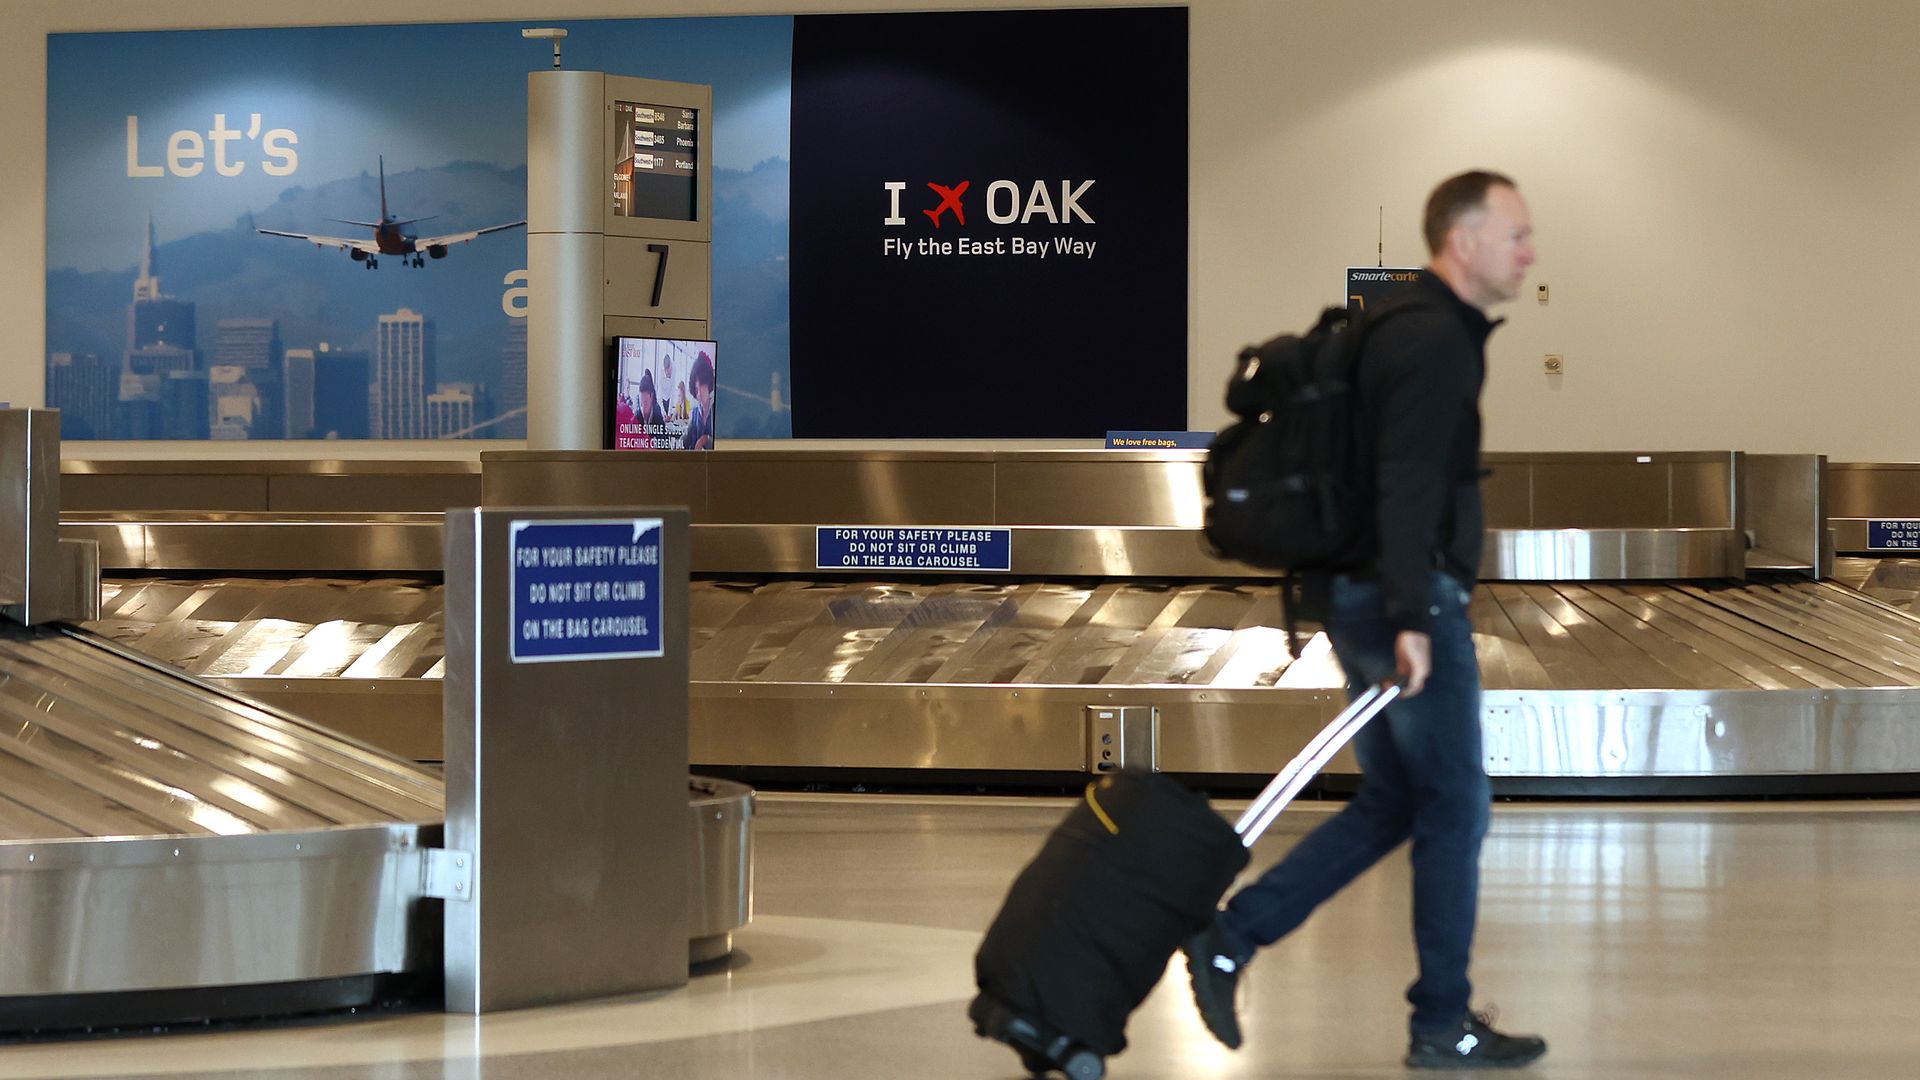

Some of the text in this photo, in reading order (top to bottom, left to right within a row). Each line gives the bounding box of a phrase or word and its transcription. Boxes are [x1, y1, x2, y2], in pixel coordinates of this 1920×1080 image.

[126, 113, 299, 178] Let's
[675, 160, 694, 170] Portland
[884, 180, 1096, 226] I OAK
[884, 237, 1097, 260] Fly the East Bay Way
[647, 244, 668, 307] 7
[619, 424, 642, 434] ONLINE
[642, 424, 664, 435] SINGLE
[619, 438, 685, 449] TEACHING CREDENTIAL
[1112, 438, 1124, 446] We
[1126, 438, 1142, 446] love
[1142, 438, 1157, 447] free
[836, 530, 992, 542] FOR YOUR SAFETY PLEASE
[516, 544, 658, 568] FOR YOUR SAFETY PLEASE
[850, 542, 978, 554] DO NOT SIT OR CLIMB
[842, 555, 980, 567] ON THE BAG CAROUSEL
[529, 580, 646, 604] DO NOT SIT OR CLIMB
[522, 616, 648, 640] ON THE BAG CAROUSEL
